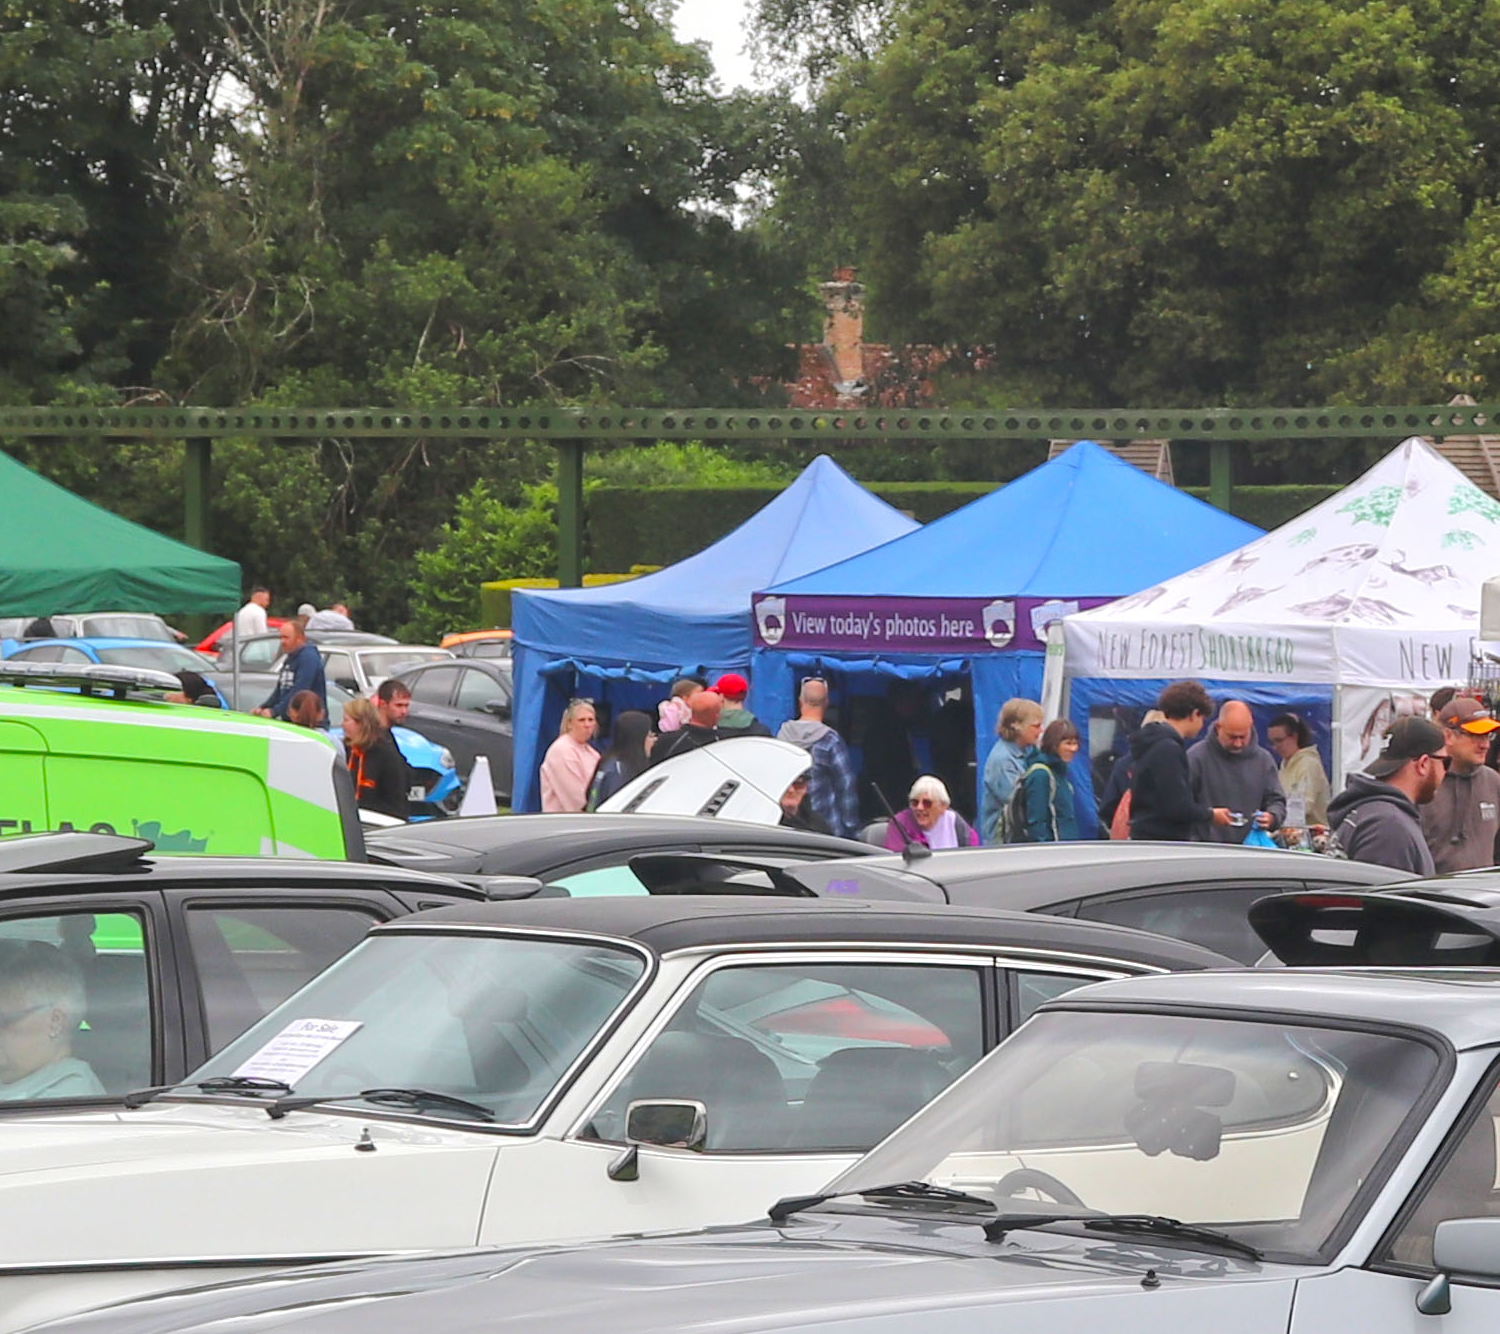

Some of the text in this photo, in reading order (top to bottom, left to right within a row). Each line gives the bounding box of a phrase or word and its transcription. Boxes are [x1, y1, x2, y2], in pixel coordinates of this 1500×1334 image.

[792, 612, 975, 641] View today's photos here
[1097, 627, 1294, 675] NEW FOREST SHORTBREAD
[1399, 636, 1453, 681] NEW
